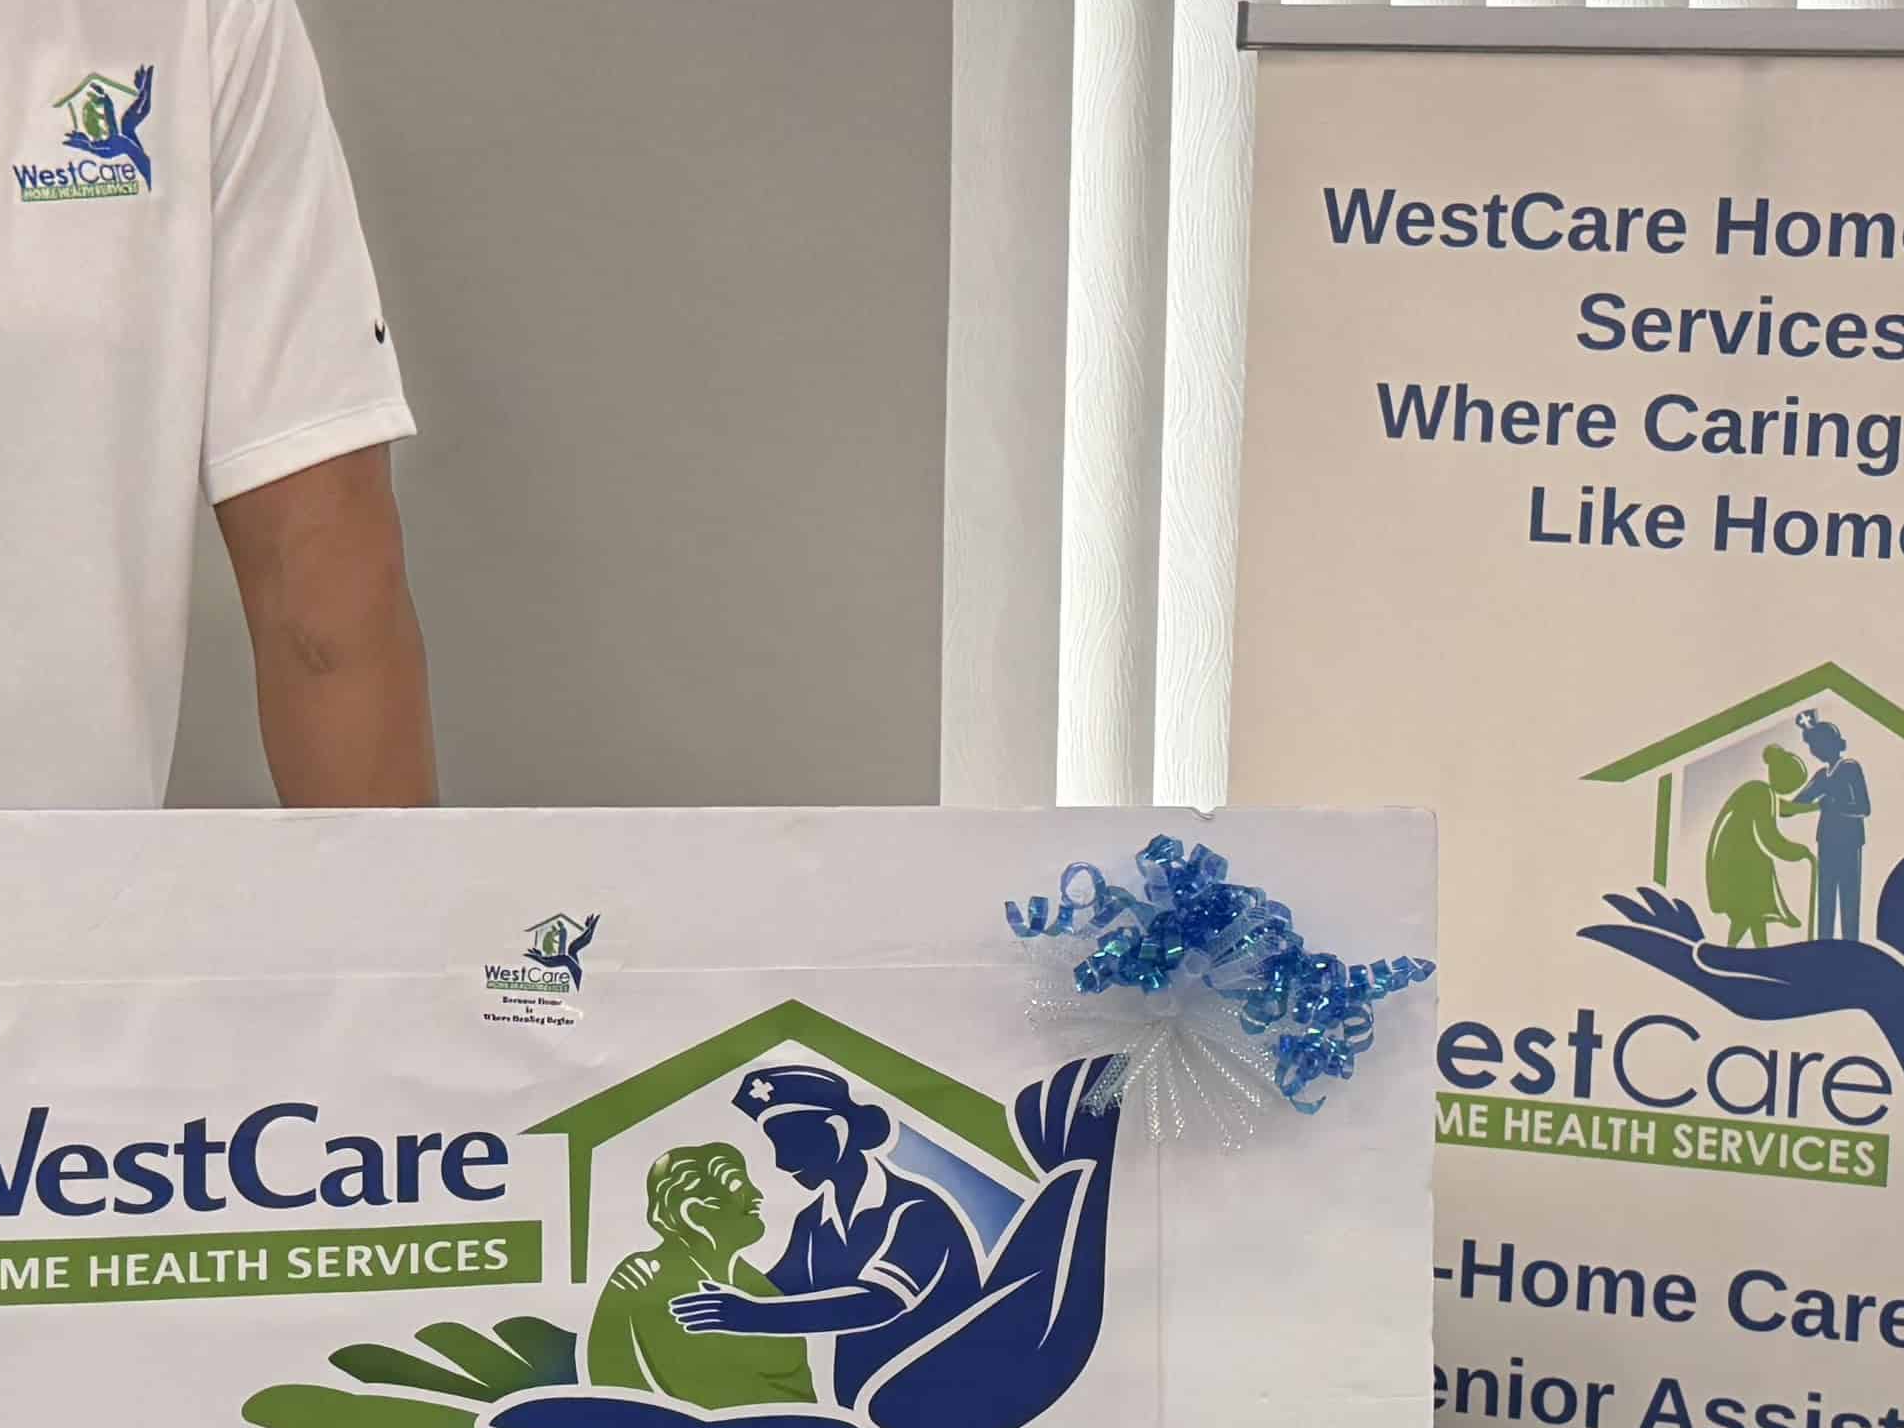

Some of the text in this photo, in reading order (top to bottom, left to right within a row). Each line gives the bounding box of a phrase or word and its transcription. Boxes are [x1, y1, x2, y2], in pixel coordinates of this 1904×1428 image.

[13, 160, 136, 189] WestCare
[1323, 187, 1688, 254] WestCare
[1376, 381, 1617, 448] Where
[1643, 393, 1903, 478] Caring
[1528, 486, 1687, 551] Like
[485, 965, 570, 983] WestCare
[1436, 1008, 1893, 1127] estCare
[1435, 1102, 1876, 1177] ME HEALTH SERVICES
[88, 1247, 269, 1287] HEALTH
[286, 1237, 509, 1279] SERVICES
[1434, 1239, 1697, 1322] -Home
